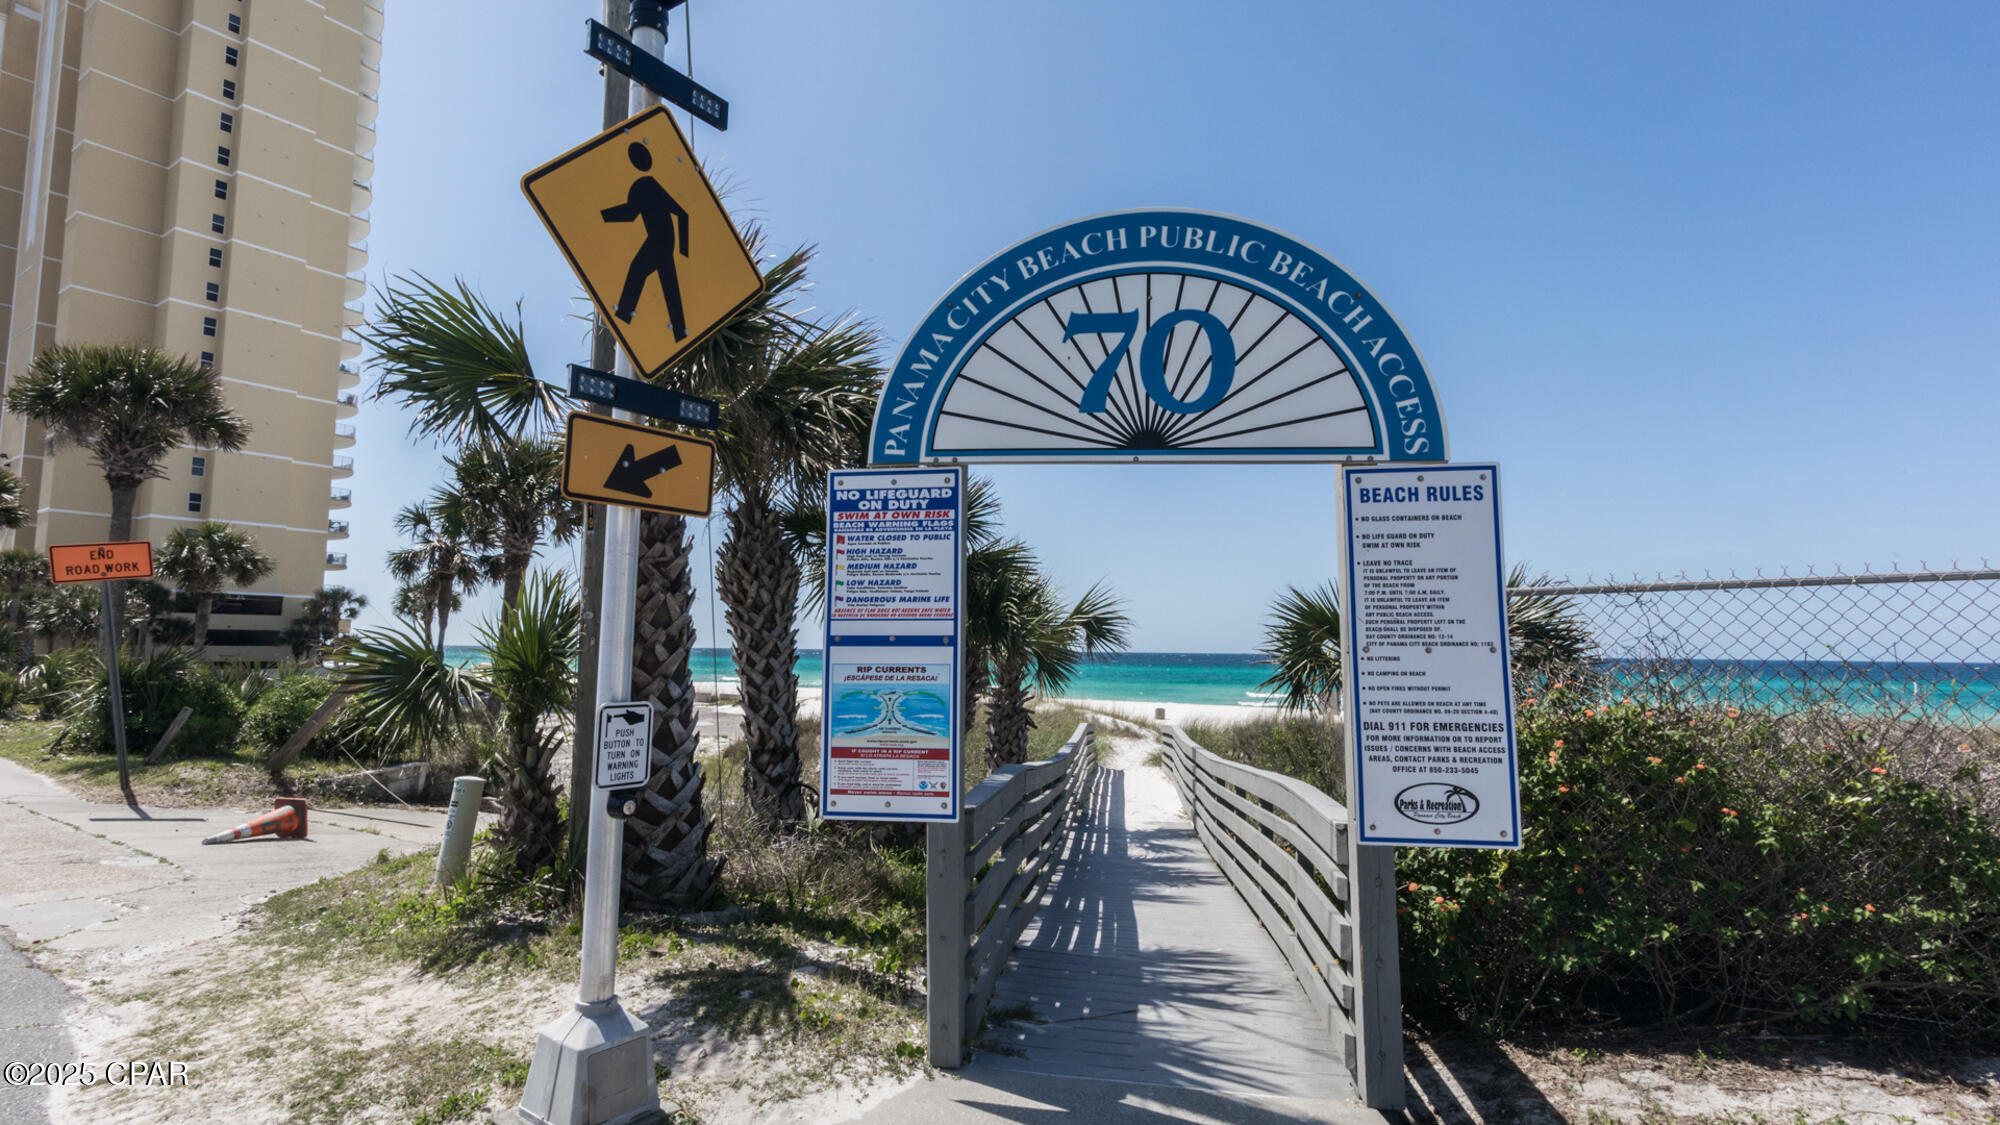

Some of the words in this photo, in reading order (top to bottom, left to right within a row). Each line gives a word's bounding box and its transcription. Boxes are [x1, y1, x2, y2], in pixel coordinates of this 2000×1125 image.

[1016, 228, 1128, 280] BEACH
[1140, 226, 1266, 264] PUBLIC
[1268, 250, 1373, 334] BEACH
[1362, 336, 1430, 455] ACCESS
[1062, 308, 1236, 415] 70
[836, 490, 860, 500] NO
[865, 488, 952, 499] LIFEGUARD
[1359, 486, 1419, 503] BEACH
[1426, 484, 1484, 501] RULES
[858, 500, 882, 509] ON
[887, 499, 928, 509] DUTY
[90, 550, 114, 560] END
[66, 564, 100, 575] ROAD
[104, 562, 140, 572] WORK
[1362, 721, 1385, 730] DIAL
[1387, 721, 1405, 730] 911
[1409, 722, 1429, 731] FOR
[1432, 722, 1504, 732] EMERGENCIES
[616, 728, 634, 737] PUSH
[604, 740, 630, 749] BUTTON
[607, 751, 625, 760] TURN
[607, 760, 638, 771] WARNING
[610, 771, 634, 781] LIGHTS
[1399, 799, 1418, 810] Parks
[1420, 800, 1424, 810] &
[1426, 800, 1462, 810] Recreation
